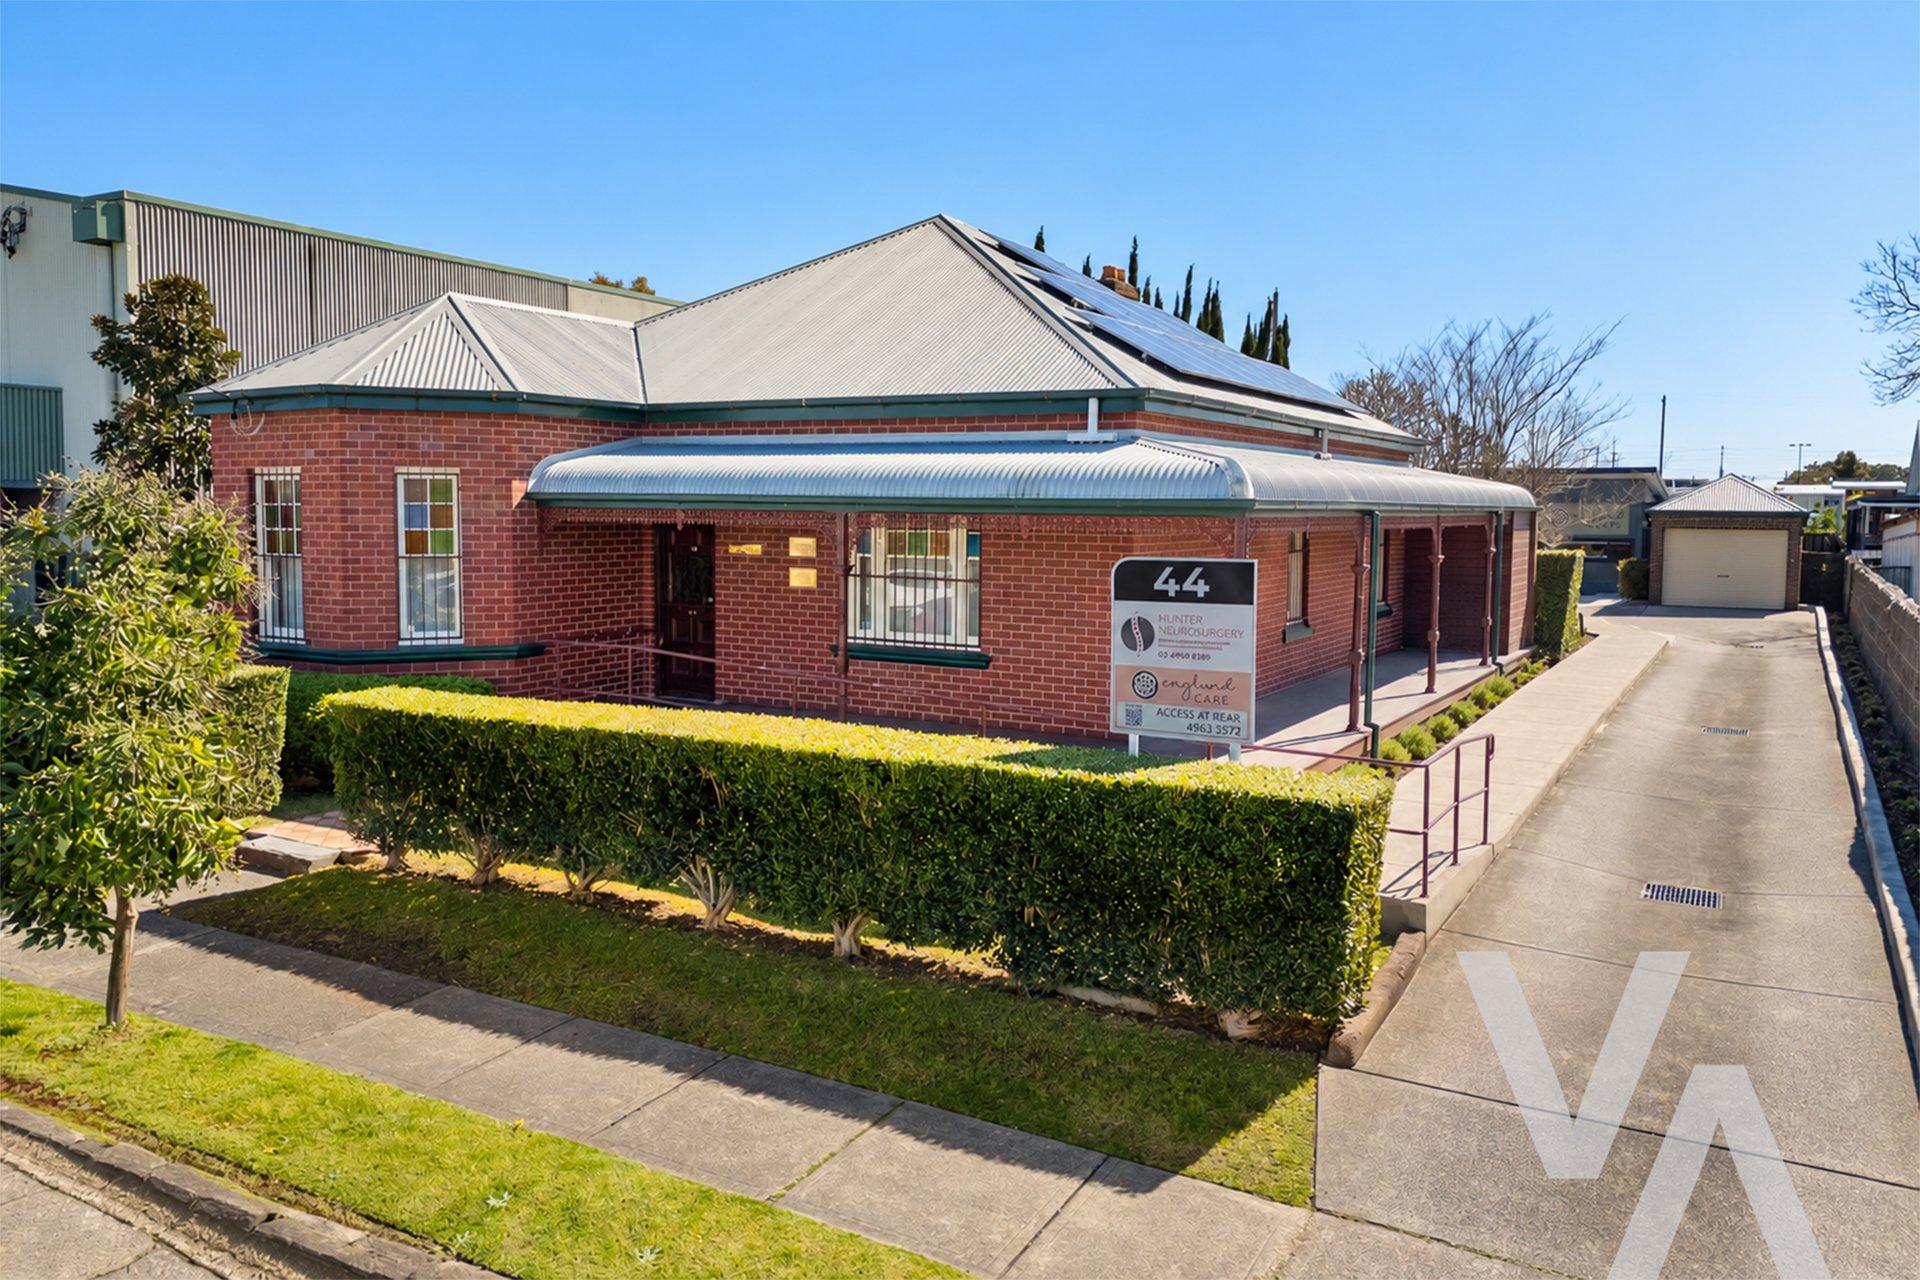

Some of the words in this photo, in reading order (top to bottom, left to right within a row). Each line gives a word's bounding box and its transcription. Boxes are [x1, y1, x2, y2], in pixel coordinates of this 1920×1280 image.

[1153, 566, 1210, 598] 44
[1158, 614, 1203, 625] HUNTER
[1158, 626, 1244, 638] NEUROSURGERY
[1194, 693, 1229, 706] CARE
[1156, 707, 1195, 719] ACCESS
[1197, 710, 1210, 720] AT
[1212, 712, 1241, 723] REAR
[1186, 723, 1212, 734] 4963
[1215, 726, 1241, 737] 5572
